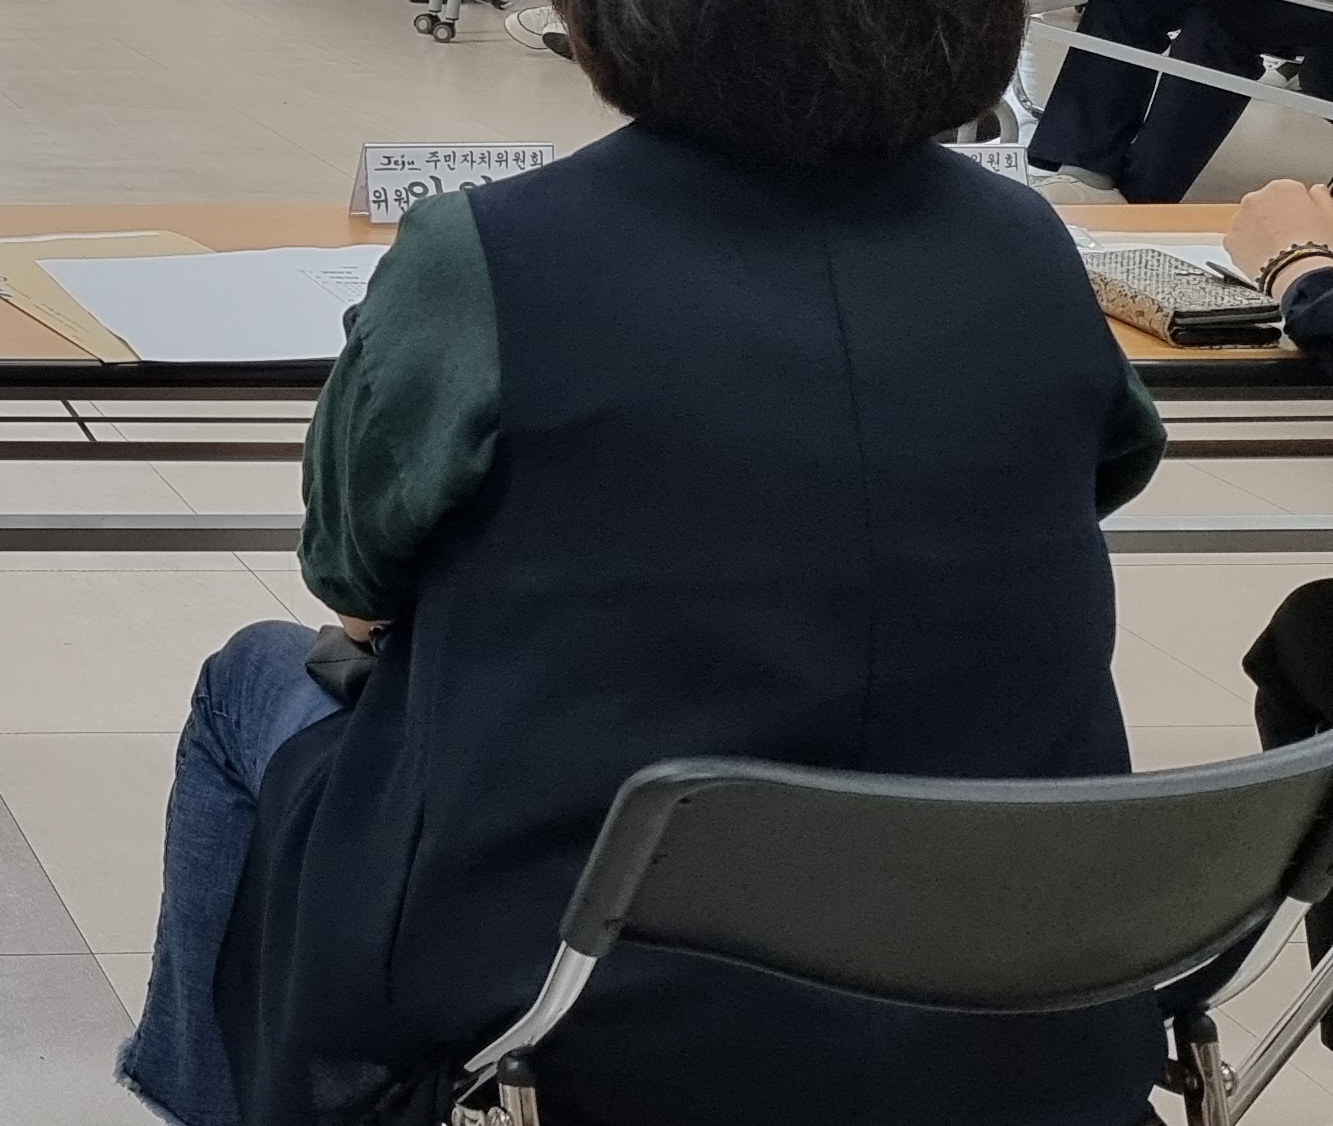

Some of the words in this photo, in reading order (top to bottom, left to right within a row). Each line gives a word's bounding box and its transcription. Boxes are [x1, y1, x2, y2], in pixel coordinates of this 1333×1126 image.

[378, 153, 417, 172] Jeju
[425, 149, 545, 171] 주민자치위원회
[371, 186, 410, 215] 위원
